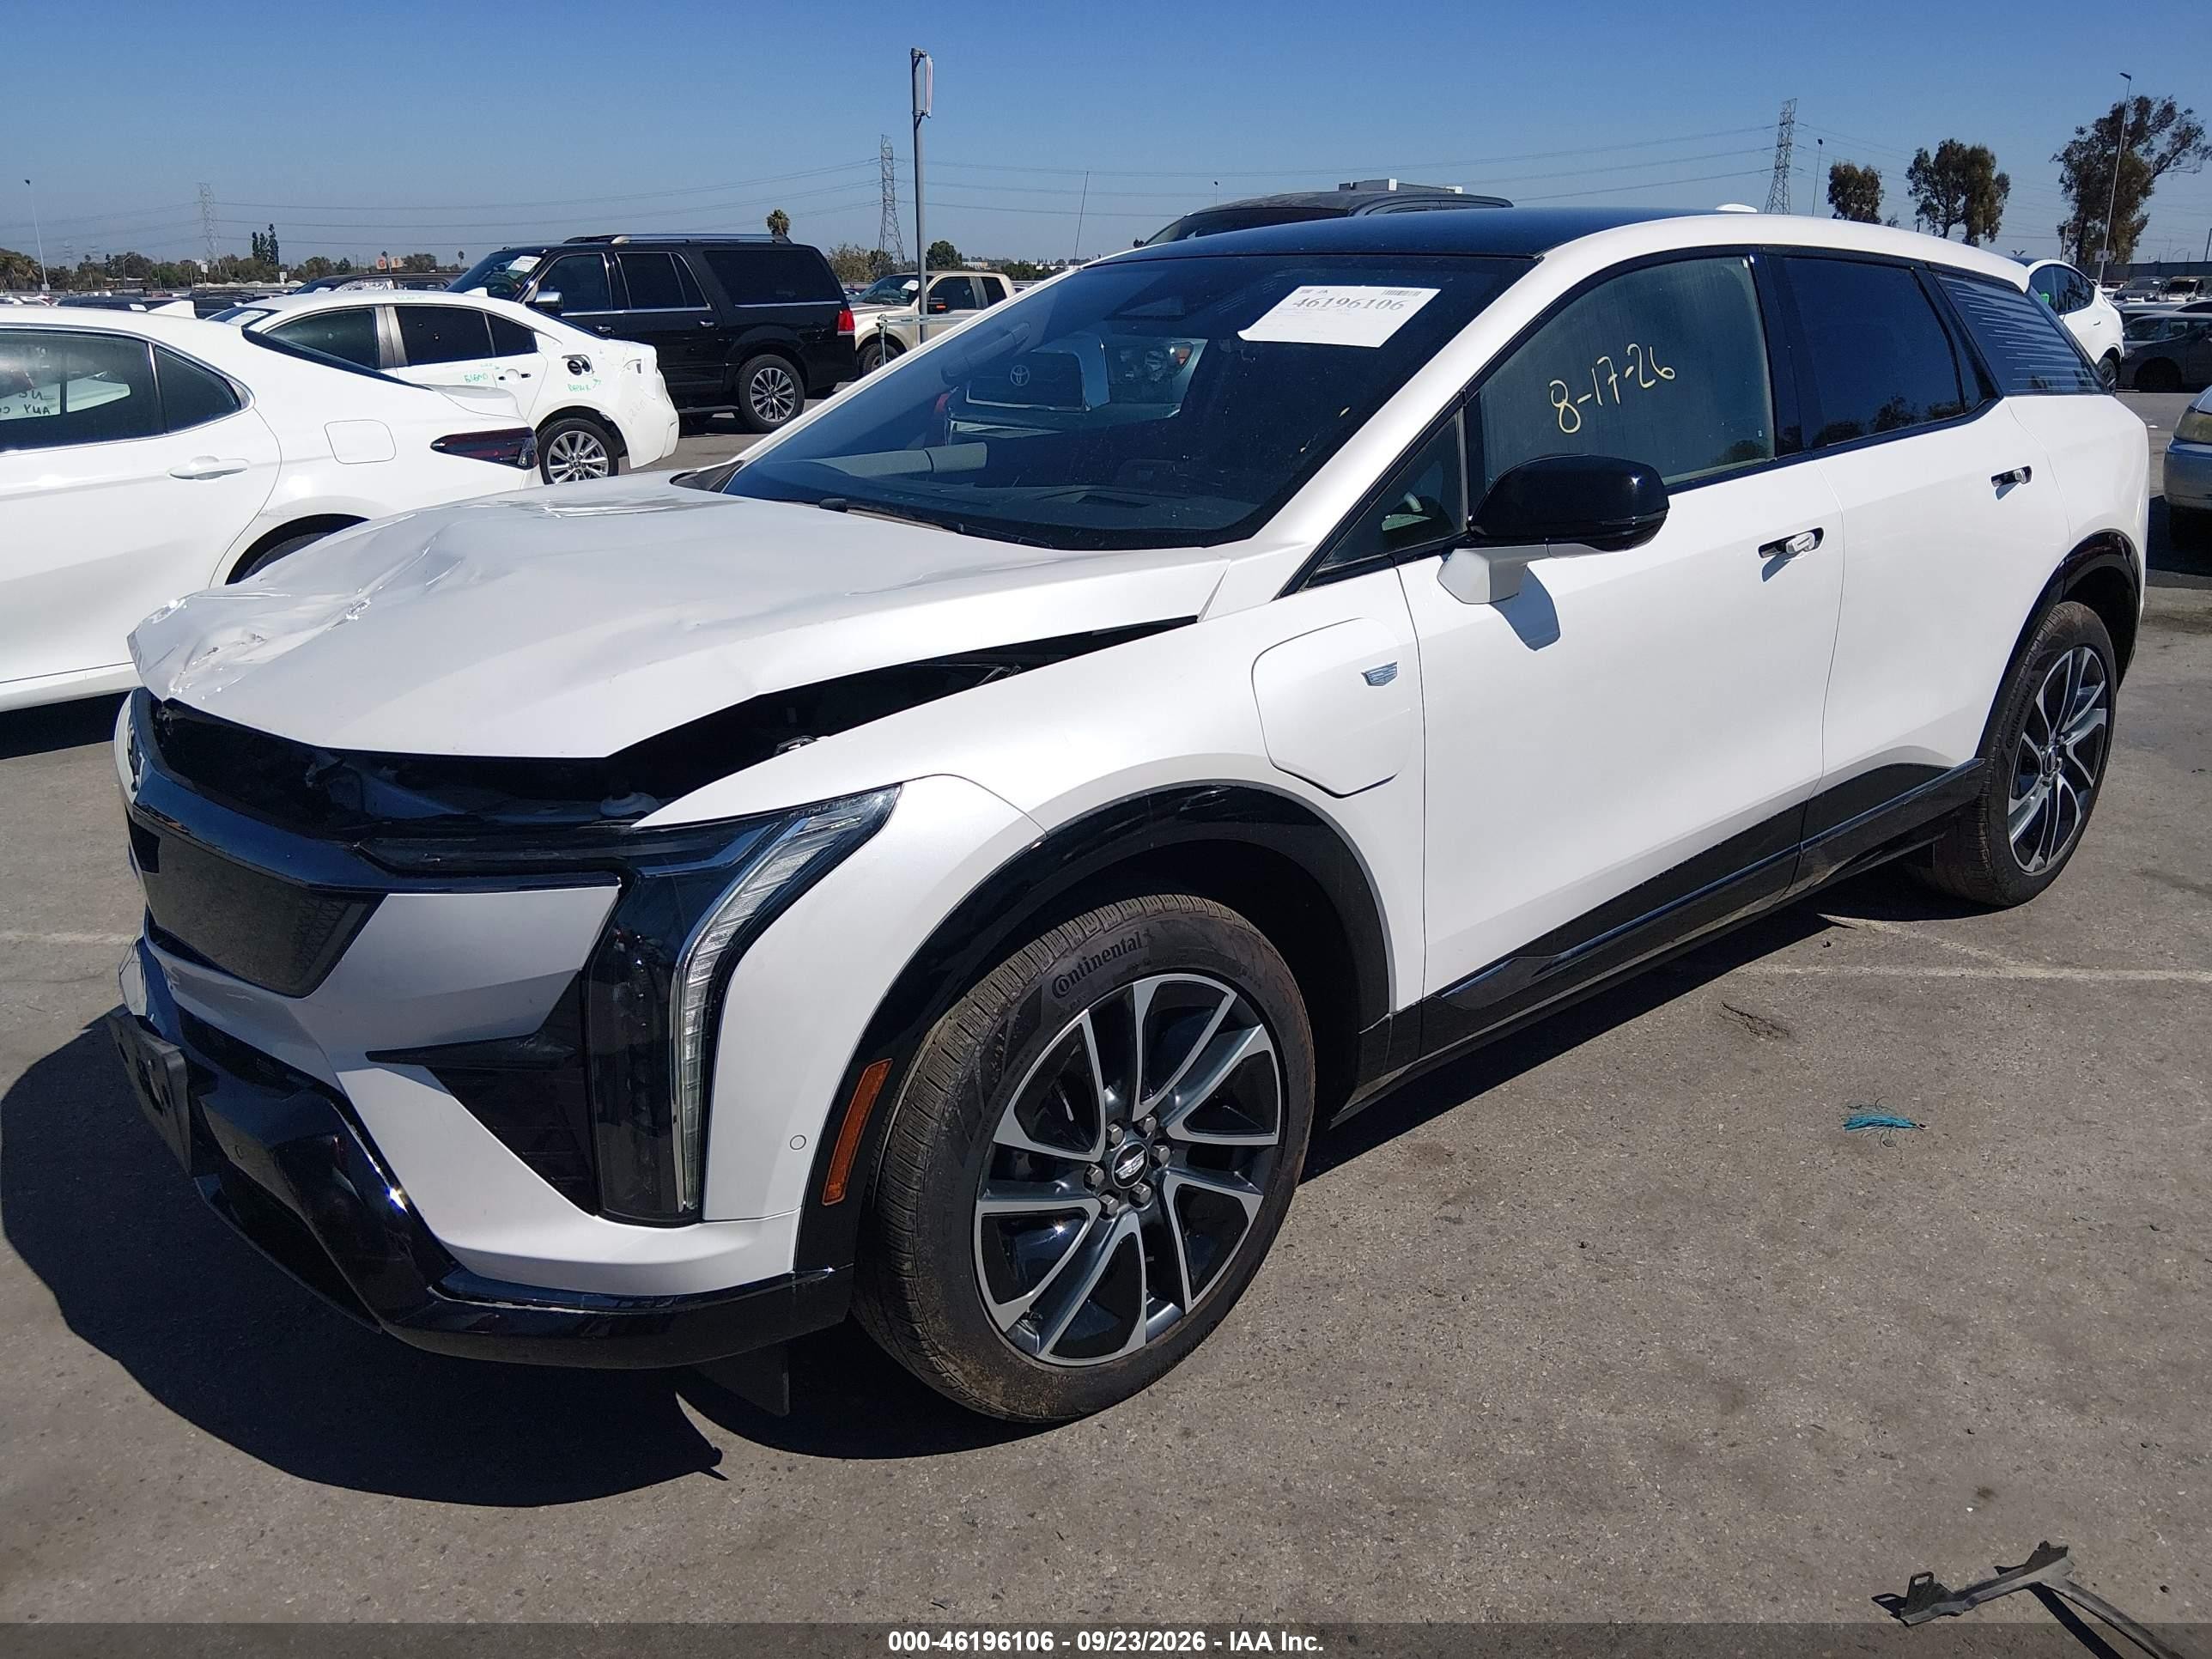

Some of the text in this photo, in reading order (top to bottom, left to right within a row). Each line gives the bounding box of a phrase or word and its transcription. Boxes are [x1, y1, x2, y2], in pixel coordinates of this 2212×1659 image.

[1291, 296, 1409, 312] 46196106
[1548, 343, 1676, 434] 8-17-26
[1052, 931, 1144, 999] Continental
